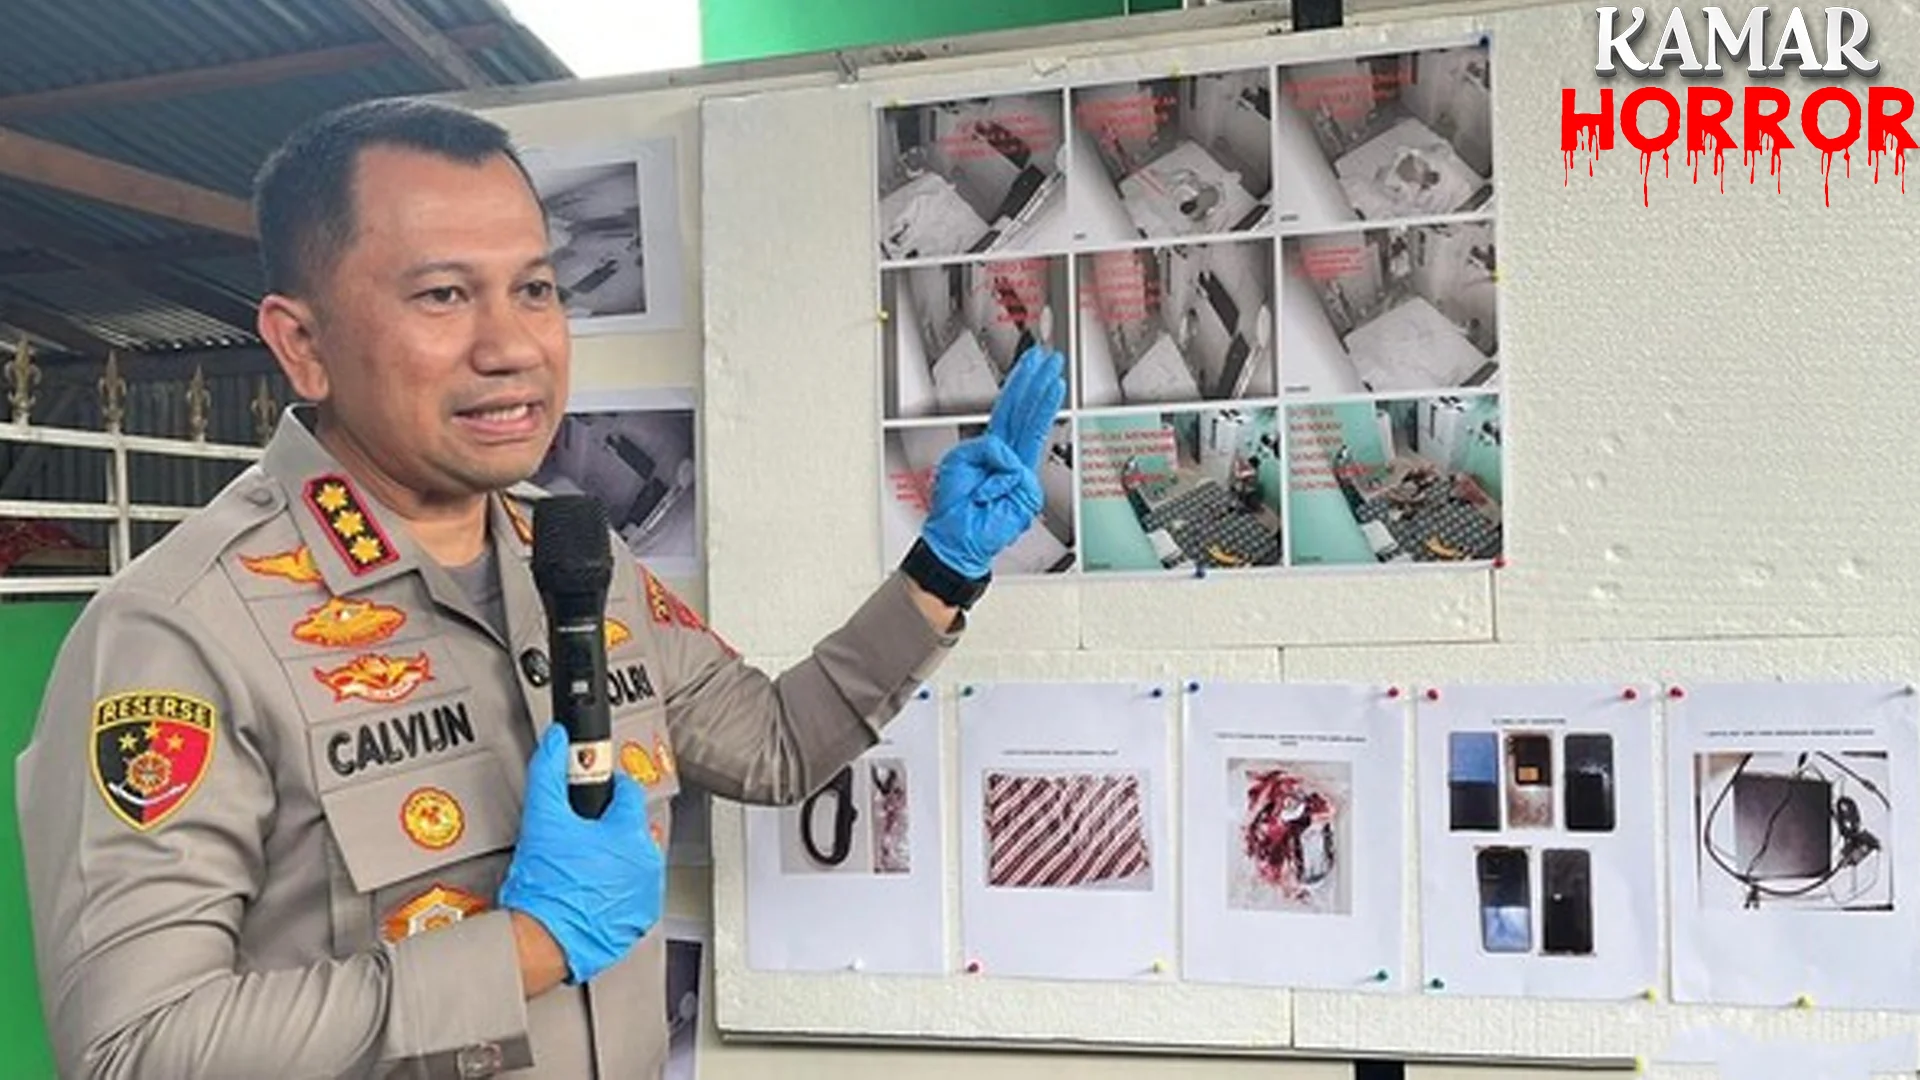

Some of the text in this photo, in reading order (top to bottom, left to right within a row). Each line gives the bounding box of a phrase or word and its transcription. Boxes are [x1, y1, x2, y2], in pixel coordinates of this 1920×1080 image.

[606, 663, 656, 707] OLRI
[102, 698, 208, 725] RESERSE
[327, 701, 475, 777] CALVIJN
